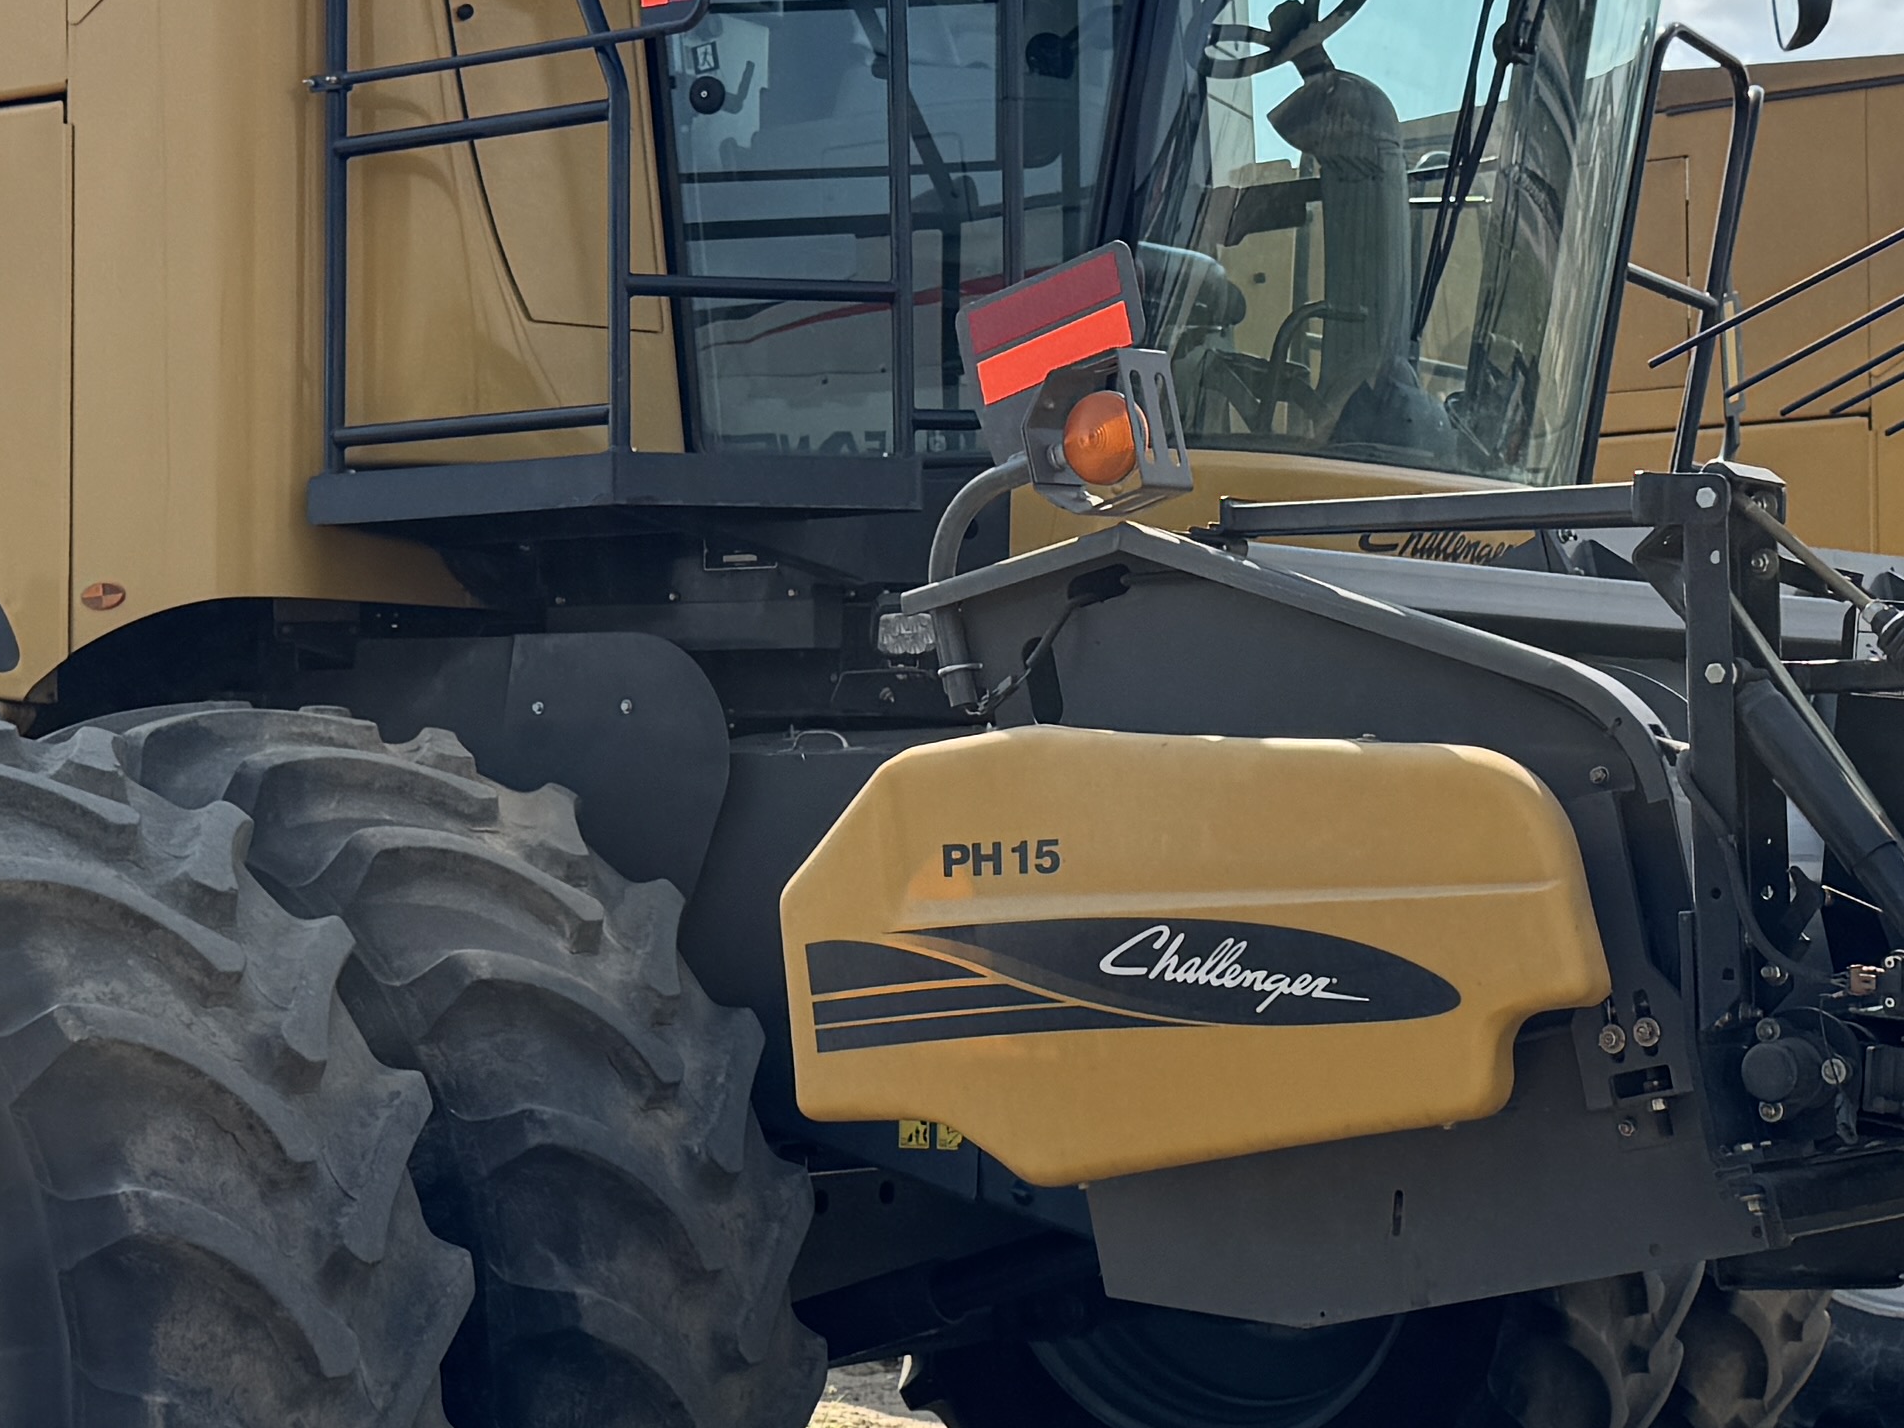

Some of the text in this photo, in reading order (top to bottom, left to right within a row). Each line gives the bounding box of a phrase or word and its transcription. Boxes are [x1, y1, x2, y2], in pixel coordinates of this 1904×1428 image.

[943, 839, 1061, 877] PH 15
[1099, 925, 1370, 1013] Challenger
